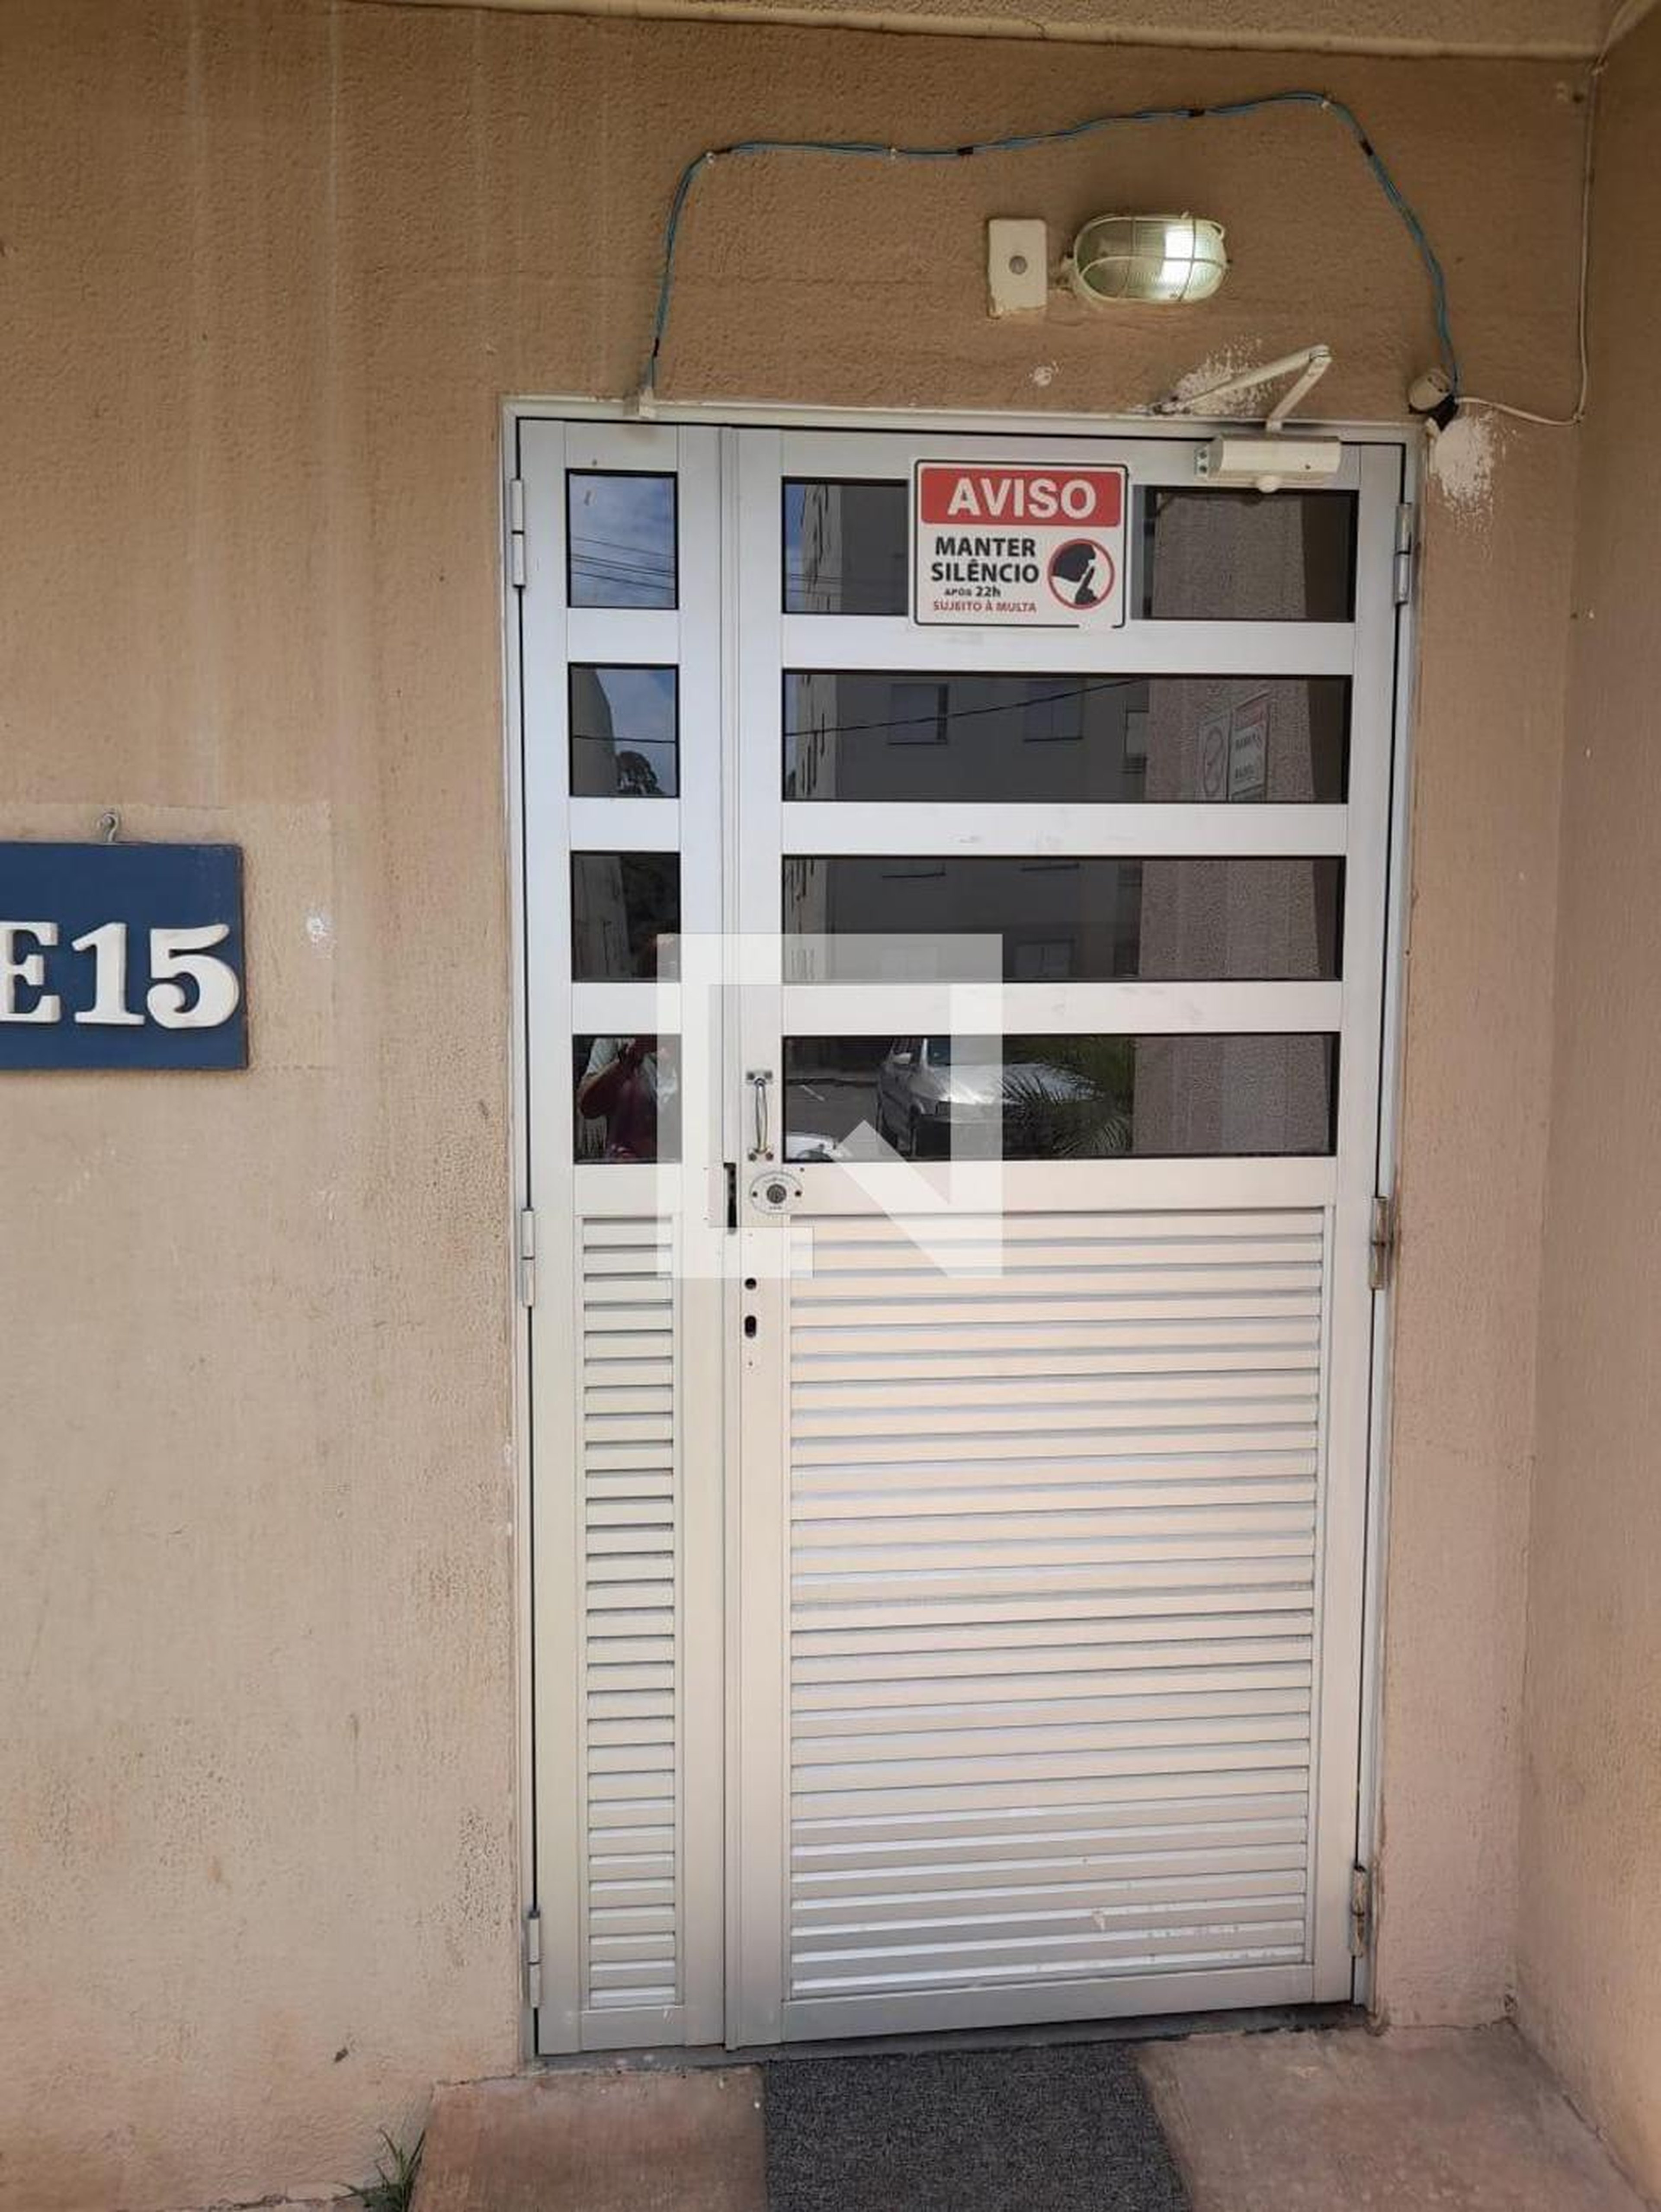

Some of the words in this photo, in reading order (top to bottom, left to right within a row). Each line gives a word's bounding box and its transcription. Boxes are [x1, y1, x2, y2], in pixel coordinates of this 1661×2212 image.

[947, 477, 1096, 519] AVISO
[936, 536, 1036, 557] MANTER
[931, 558, 1039, 583] SILÊNCIO
[975, 586, 1001, 597] 22h
[933, 601, 982, 612] SUJEITO
[996, 602, 1038, 613] MULTA
